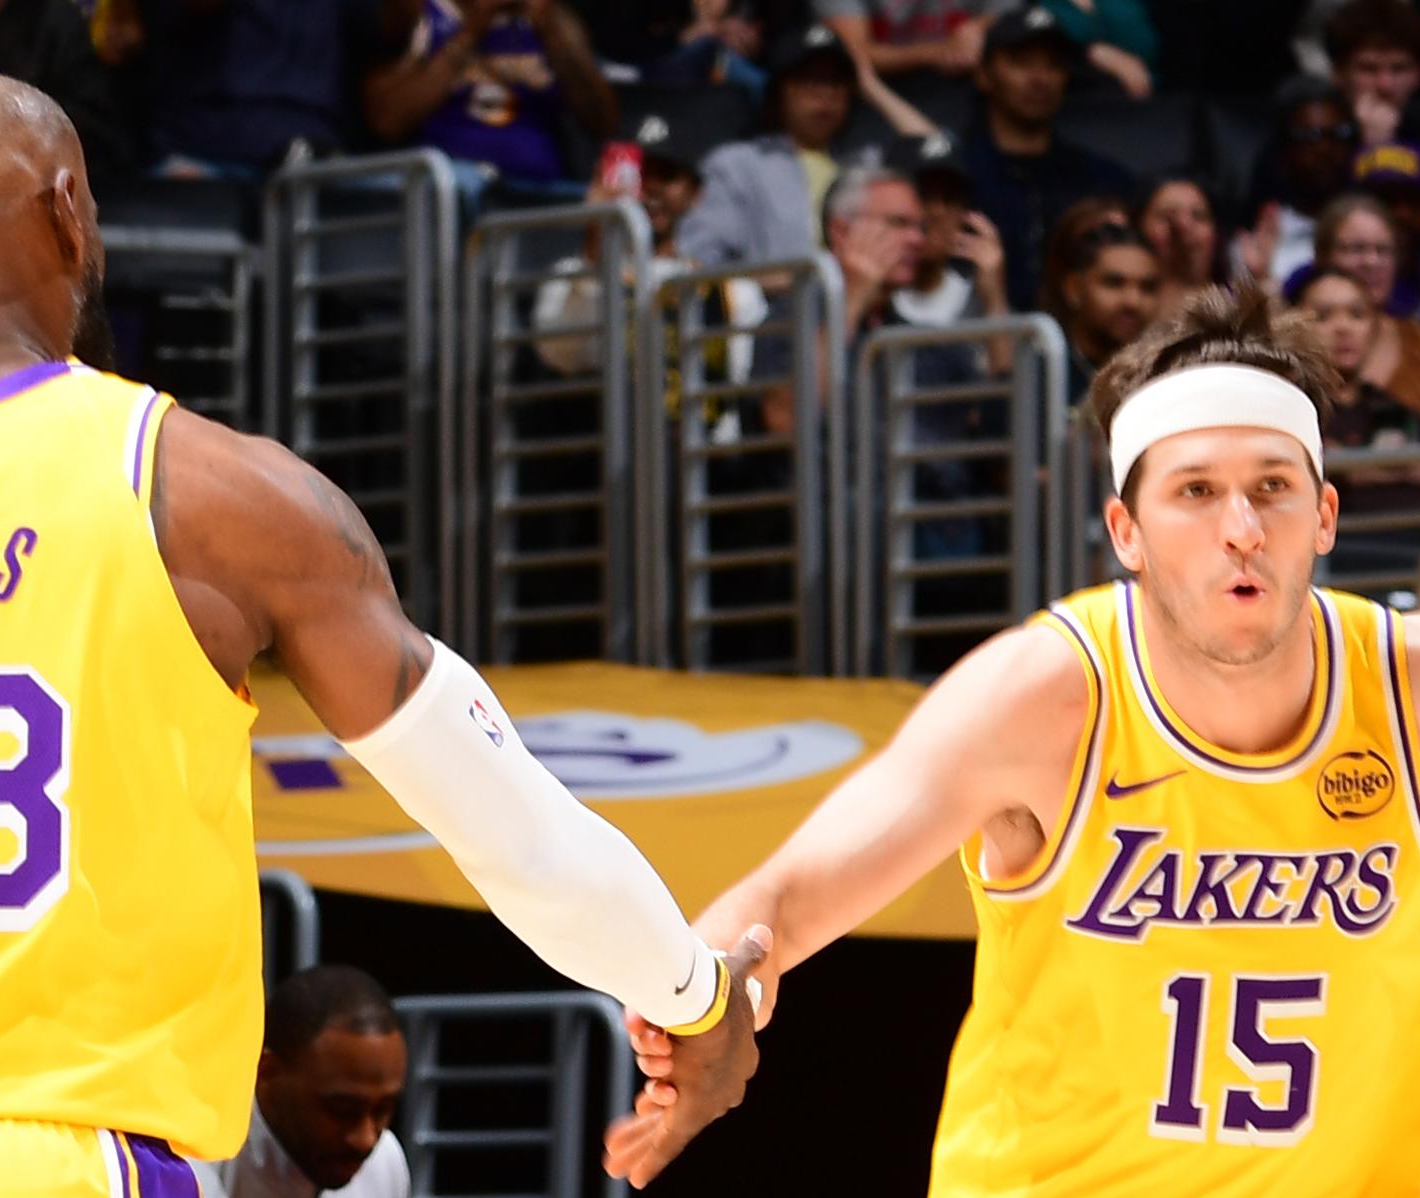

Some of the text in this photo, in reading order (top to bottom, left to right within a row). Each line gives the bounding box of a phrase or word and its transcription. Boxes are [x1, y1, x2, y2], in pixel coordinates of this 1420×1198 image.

[1323, 769, 1389, 798] bibigo
[1065, 824, 1401, 946] LAKERS
[1148, 972, 1330, 1149] 15
